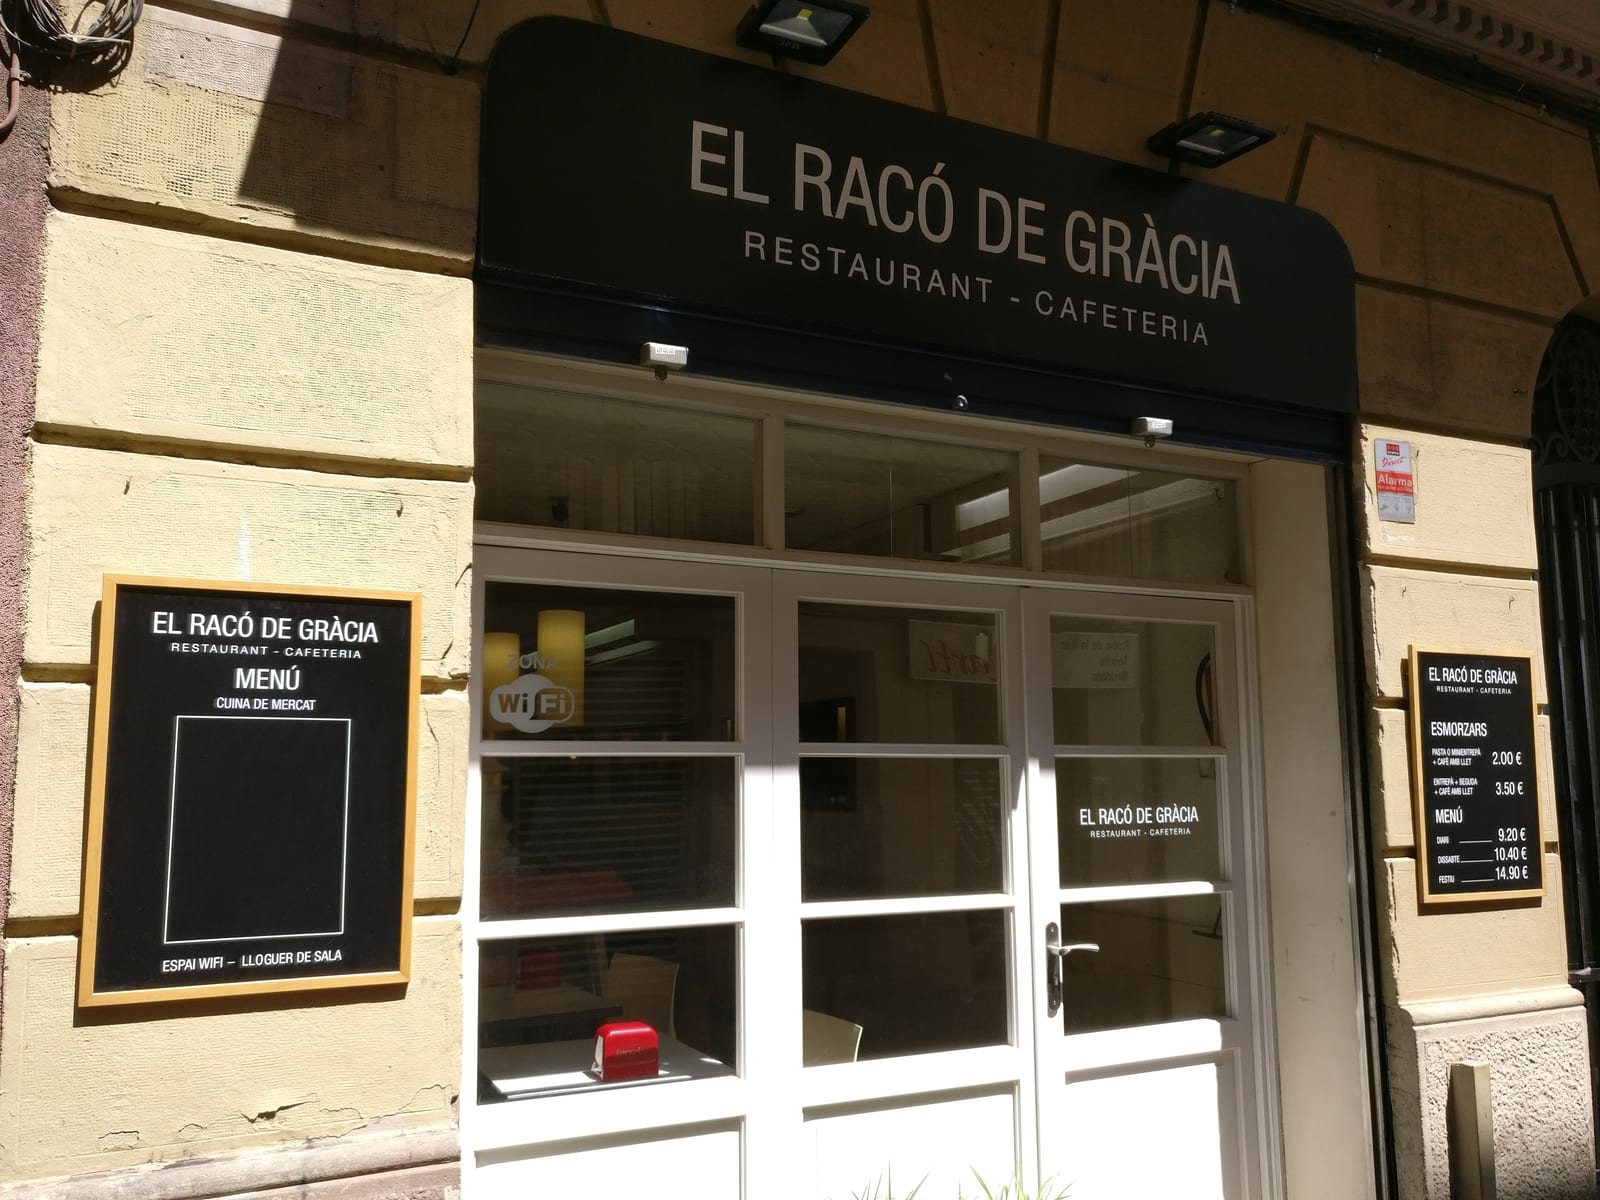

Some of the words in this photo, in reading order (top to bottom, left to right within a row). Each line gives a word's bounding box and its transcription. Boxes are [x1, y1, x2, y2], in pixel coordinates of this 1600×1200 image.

[691, 120, 769, 205] EL
[794, 142, 954, 243] RACÓ
[978, 187, 1046, 264] DE
[1064, 210, 1241, 304] GRÀCIA
[744, 230, 993, 303] RESTAURANT
[1035, 290, 1209, 346] CAFETERIA
[1378, 473, 1413, 487] Alarma
[152, 611, 182, 635] EL
[189, 611, 254, 638] RACÓ
[261, 616, 292, 639] DE
[299, 615, 379, 643] GRÀCIA
[171, 642, 269, 656] RESTAURANT
[285, 647, 362, 659] CAFETERIA
[506, 653, 558, 669] ZONA
[234, 665, 301, 691] MENÚ
[1428, 666, 1441, 682] EL
[1442, 665, 1468, 683] RACÓ
[1470, 668, 1483, 684] DE
[1484, 667, 1518, 685] GRÀCIA
[1436, 685, 1474, 694] RESTAURANT
[1480, 687, 1512, 695] CAFETERIA
[216, 696, 250, 710] CUINA
[253, 698, 269, 710] DE
[271, 698, 317, 711] MERCAT
[1430, 721, 1488, 737] ESMORZARS
[1431, 748, 1447, 756] PASTA
[1492, 751, 1514, 766] 2.00
[1515, 751, 1522, 766] €
[1449, 758, 1460, 766] AMB
[1460, 757, 1472, 766] LLET
[1459, 777, 1478, 786] BEGUDA
[1495, 781, 1515, 796] 3.50
[1517, 781, 1524, 796] €
[1450, 787, 1461, 796] AMB
[1462, 787, 1473, 796] LLET
[1079, 808, 1096, 825] EL
[1098, 803, 1133, 825] RACÓ
[1136, 807, 1153, 824] DE
[1155, 803, 1199, 824] GRÀCIA
[1435, 805, 1463, 824] MENÚ
[1090, 829, 1141, 838] RESTAURANT
[1149, 827, 1191, 836] CAFETERIA
[1498, 827, 1518, 842] 9.20
[1520, 827, 1527, 842] €
[1437, 855, 1460, 864] DISSABTE
[1494, 846, 1519, 861] 10.40
[1521, 846, 1527, 860] €
[1438, 875, 1455, 884] FESTIU
[1495, 865, 1520, 880] 14.90
[1522, 865, 1529, 879] €
[162, 959, 196, 972] ESPAI
[199, 956, 224, 970] WIFI
[241, 952, 294, 967] LLOGUER
[296, 951, 311, 963] DE
[314, 949, 342, 962] SALA
